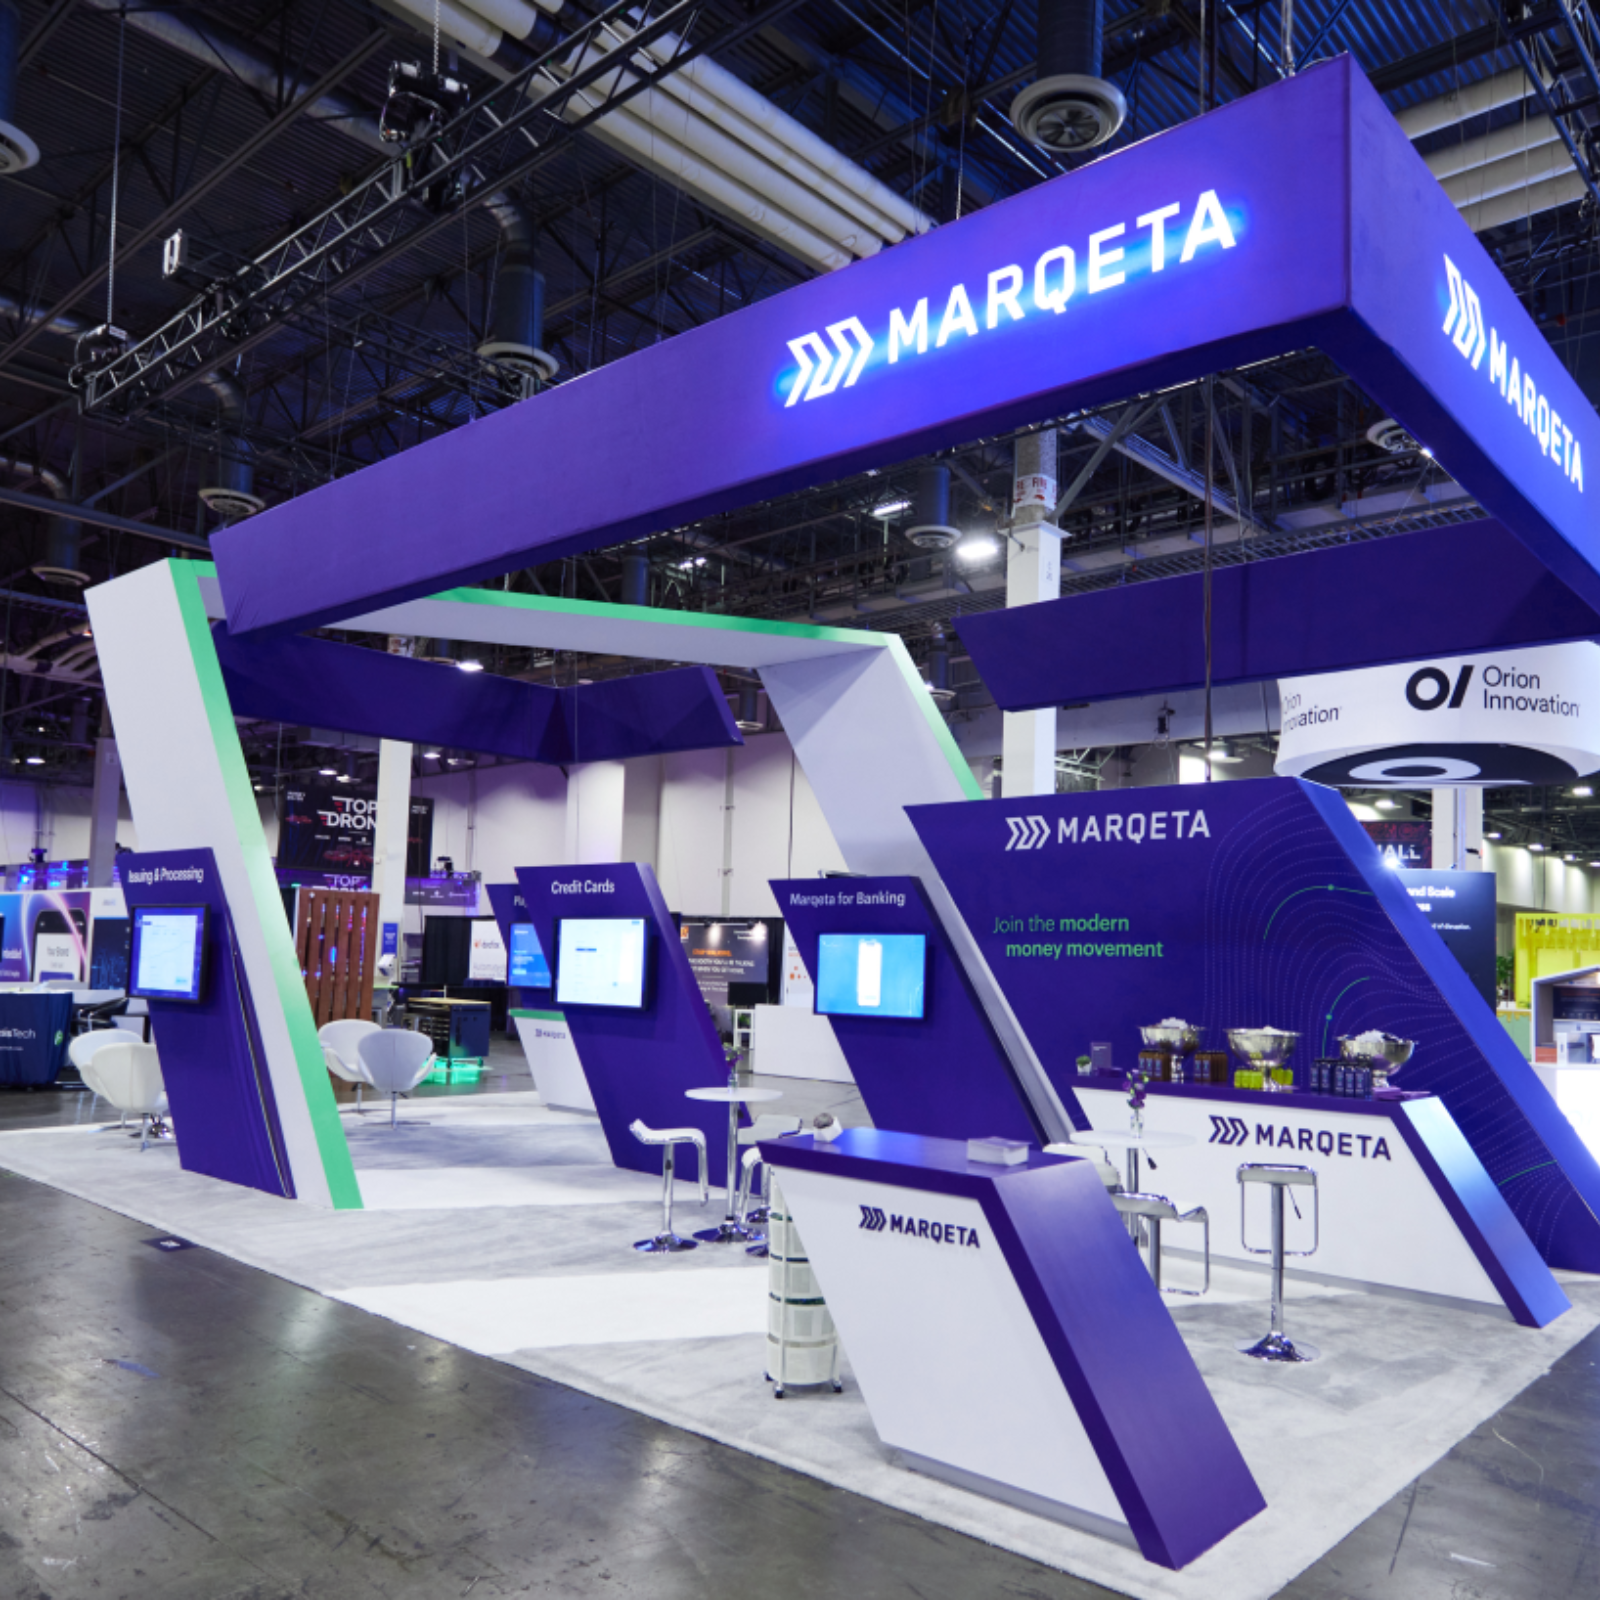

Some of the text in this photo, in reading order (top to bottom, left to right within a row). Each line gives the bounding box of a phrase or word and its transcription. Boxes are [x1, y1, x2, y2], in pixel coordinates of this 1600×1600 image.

[887, 188, 1237, 365] MARQETA
[1489, 326, 1583, 494] MARQETA
[1482, 665, 1541, 690] Orion
[1483, 689, 1580, 718] Innovation
[317, 810, 376, 830] DRON
[1057, 810, 1211, 844] MARQETA
[128, 869, 153, 885] Issuing
[160, 865, 204, 883] Processing
[551, 879, 615, 894] Credit Cards
[838, 891, 854, 905] for
[856, 890, 906, 907] Banking
[993, 913, 1130, 934] Join the modern
[1006, 941, 1164, 961] money movement
[1255, 1123, 1391, 1161] MARQETA
[890, 1213, 980, 1249] MARQETA
